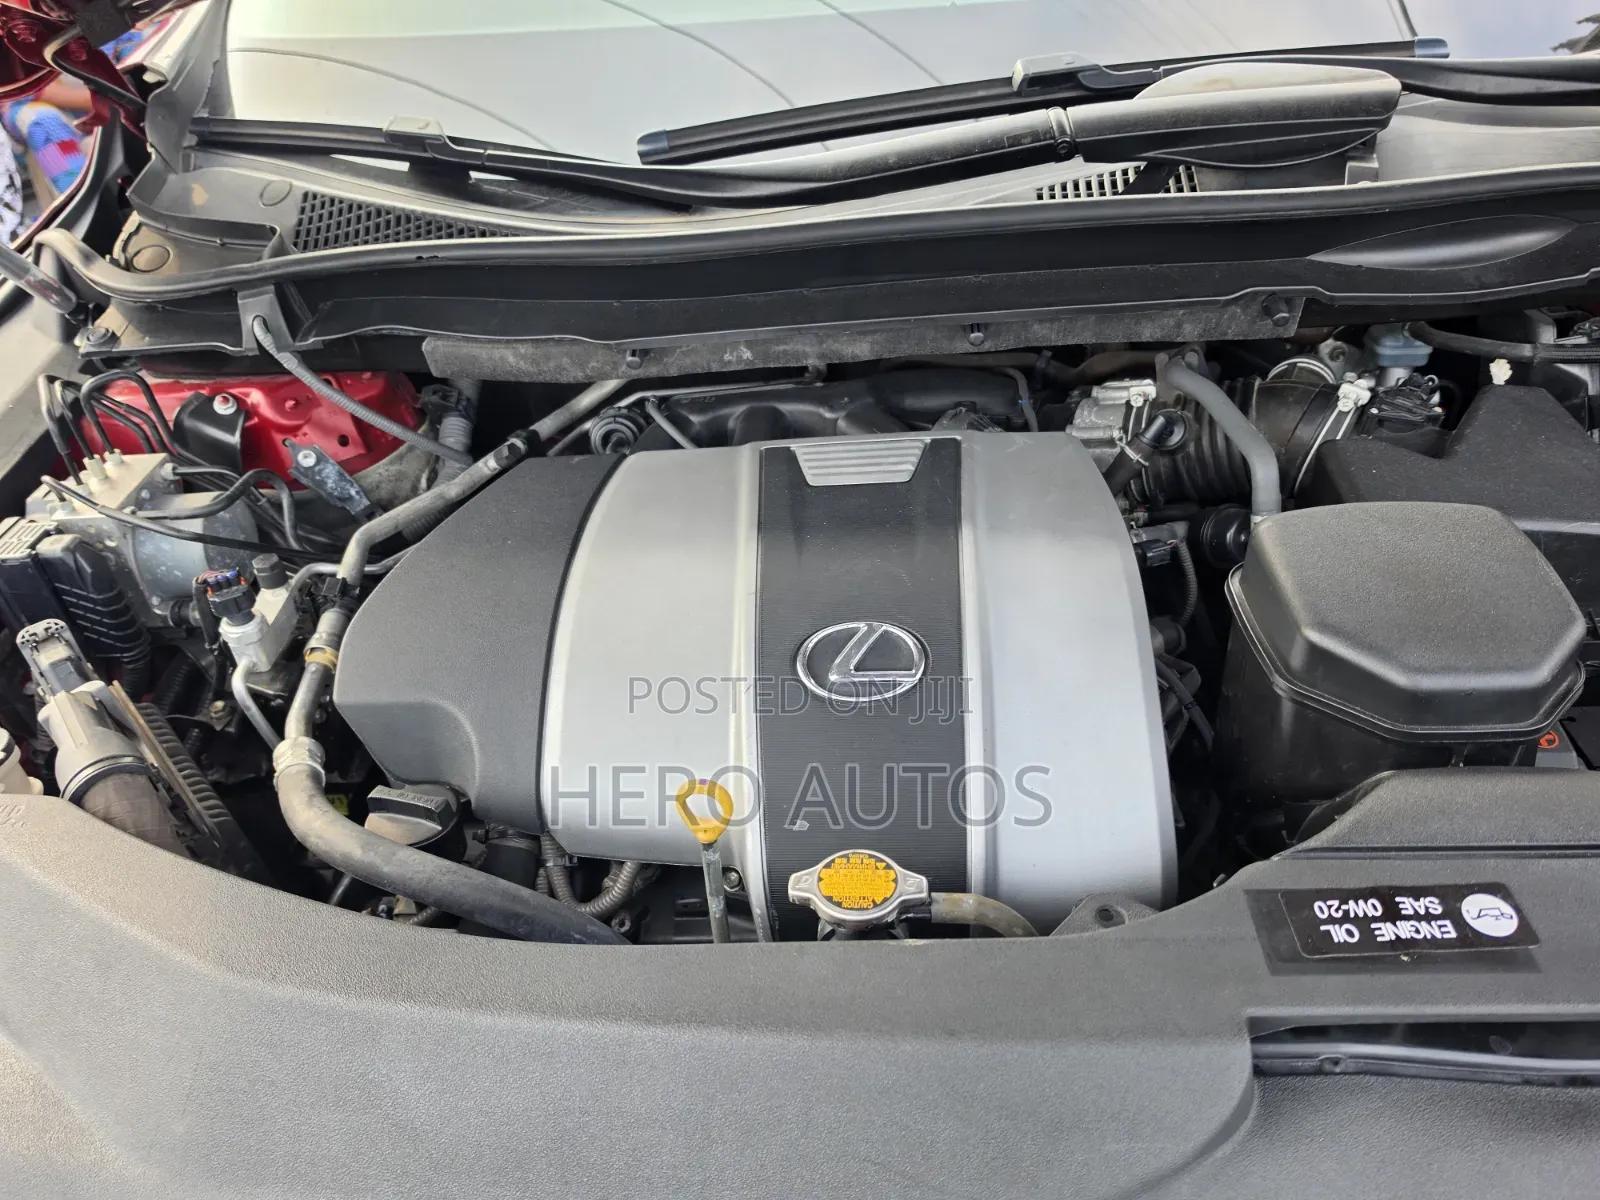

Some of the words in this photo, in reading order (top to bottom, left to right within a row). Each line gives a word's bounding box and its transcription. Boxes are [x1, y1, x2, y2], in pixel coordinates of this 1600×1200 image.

[841, 901, 874, 909] CAUTION
[1313, 898, 1383, 919] 0W-20
[1395, 896, 1443, 916] SAE
[1319, 923, 1361, 943] OIL
[1370, 919, 1458, 942] ENGINE
